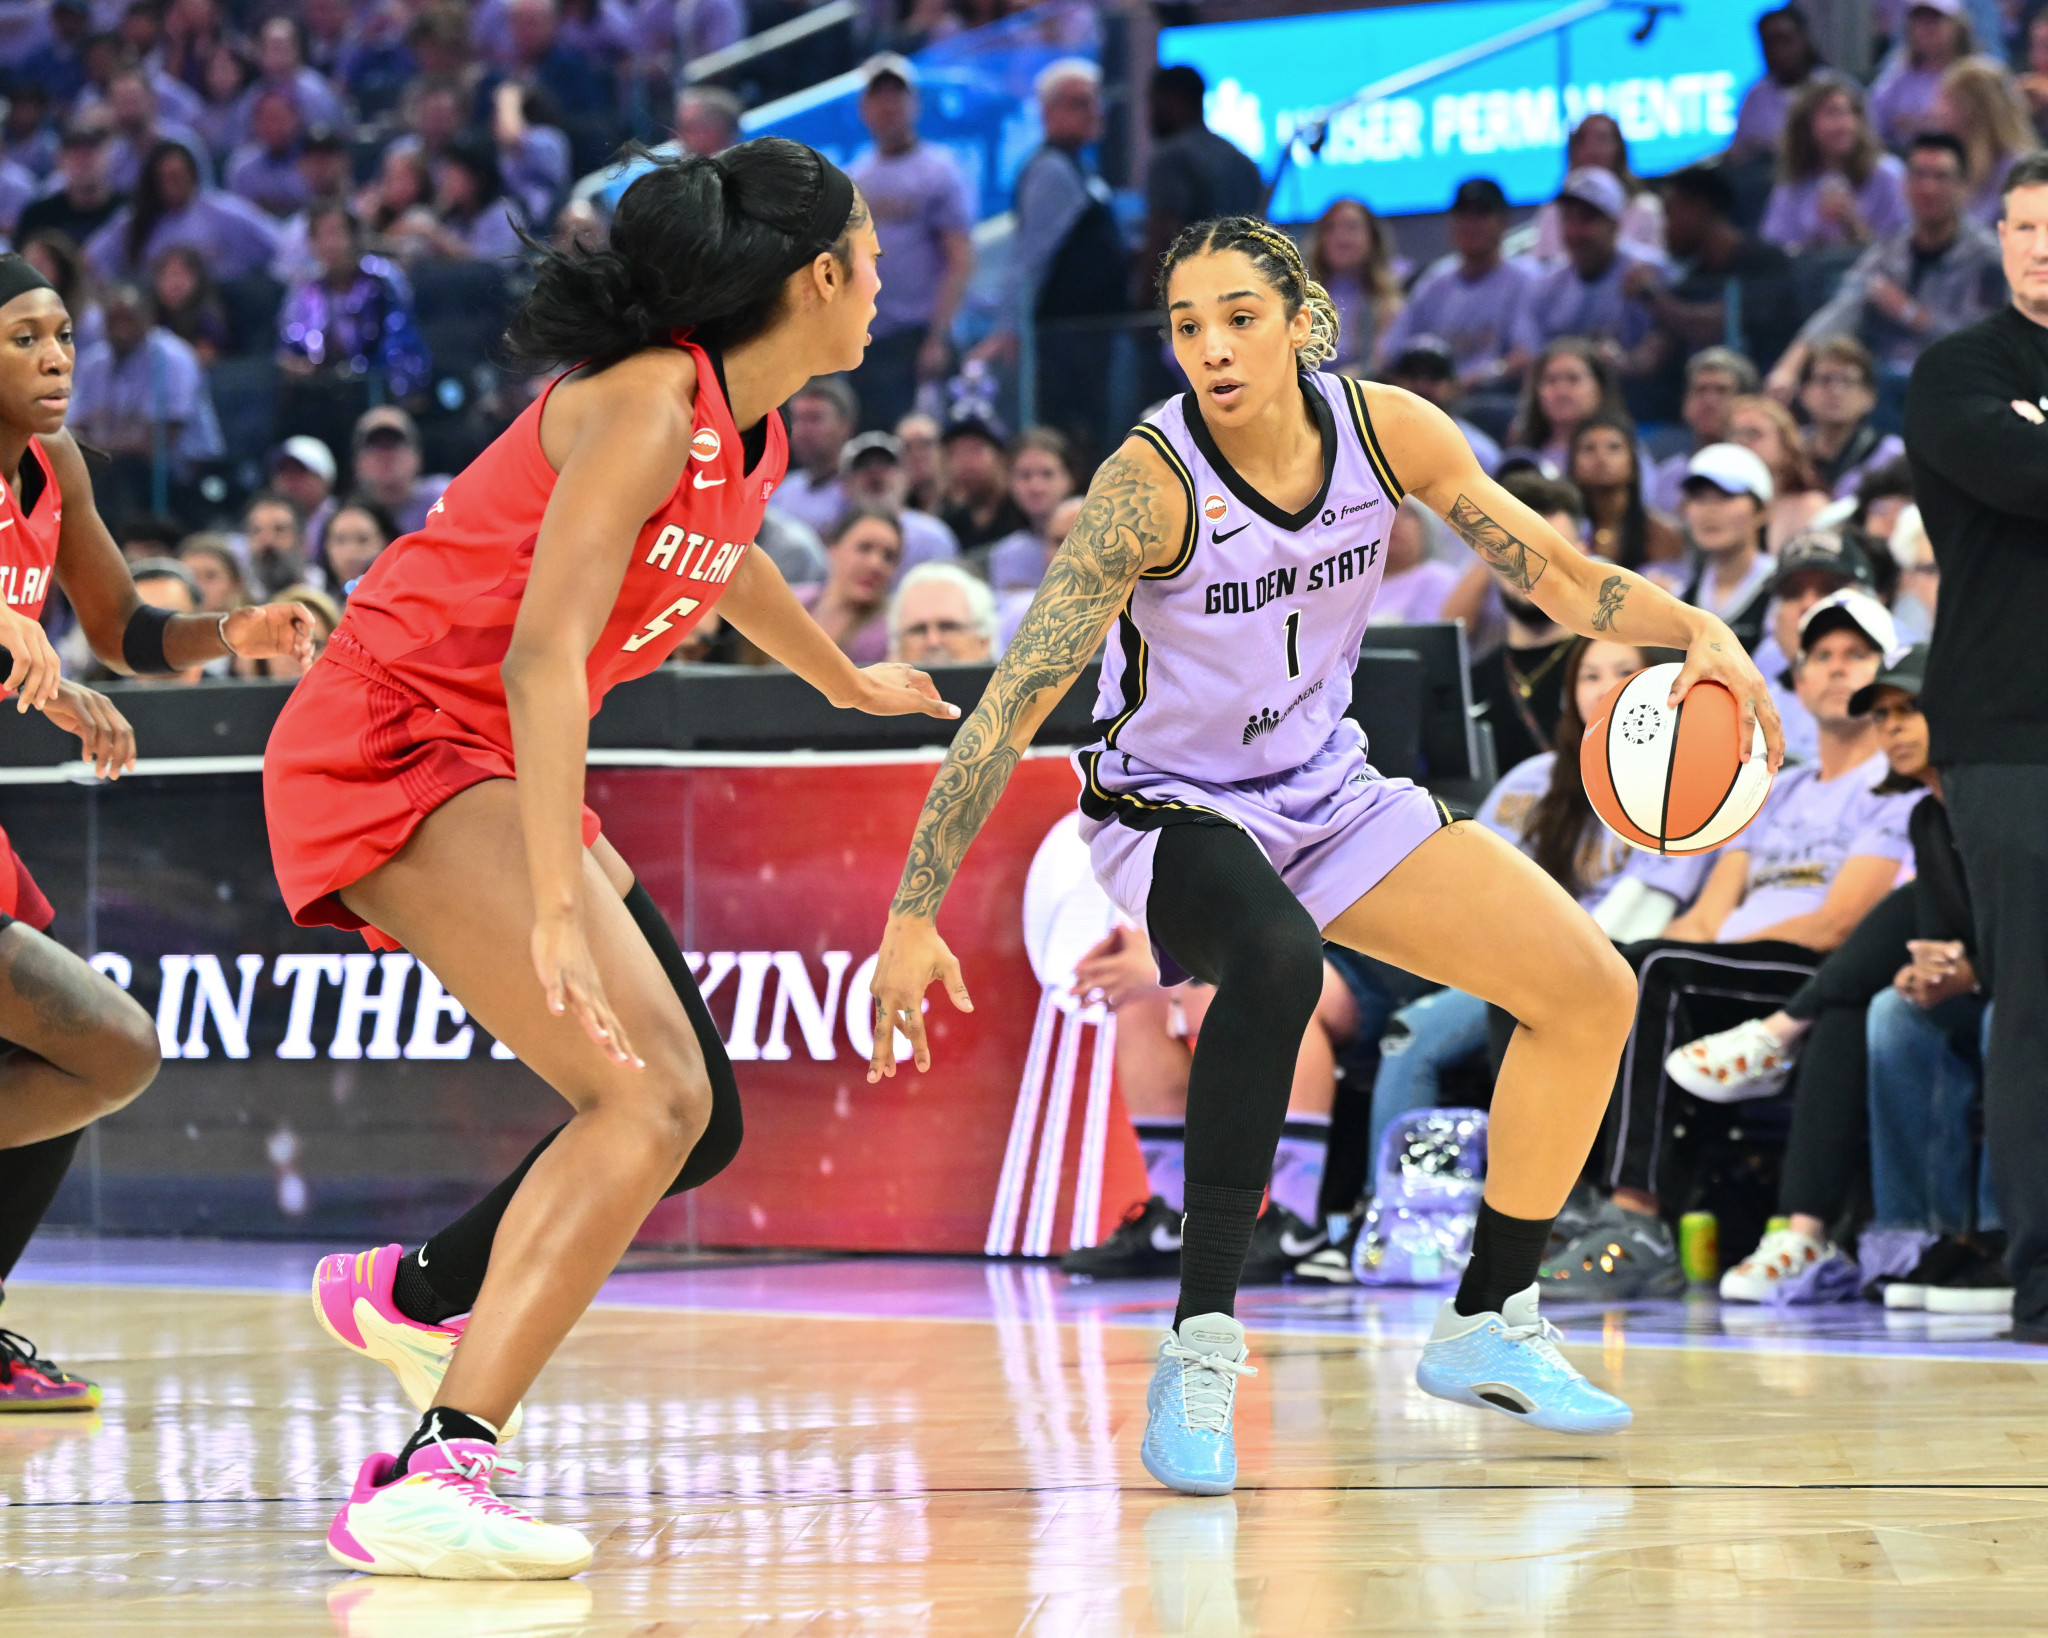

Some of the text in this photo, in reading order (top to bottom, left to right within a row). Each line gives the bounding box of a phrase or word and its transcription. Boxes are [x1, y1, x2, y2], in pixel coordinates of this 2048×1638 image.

[1275, 97, 1424, 167] ISER
[1340, 498, 1379, 520] freedom
[645, 523, 749, 584] ATLAN
[1204, 538, 1381, 615] GOLDEN STATE
[621, 596, 701, 652] 5
[1282, 608, 1302, 682] 1
[156, 953, 264, 1060] IN
[272, 952, 475, 1060] THE
